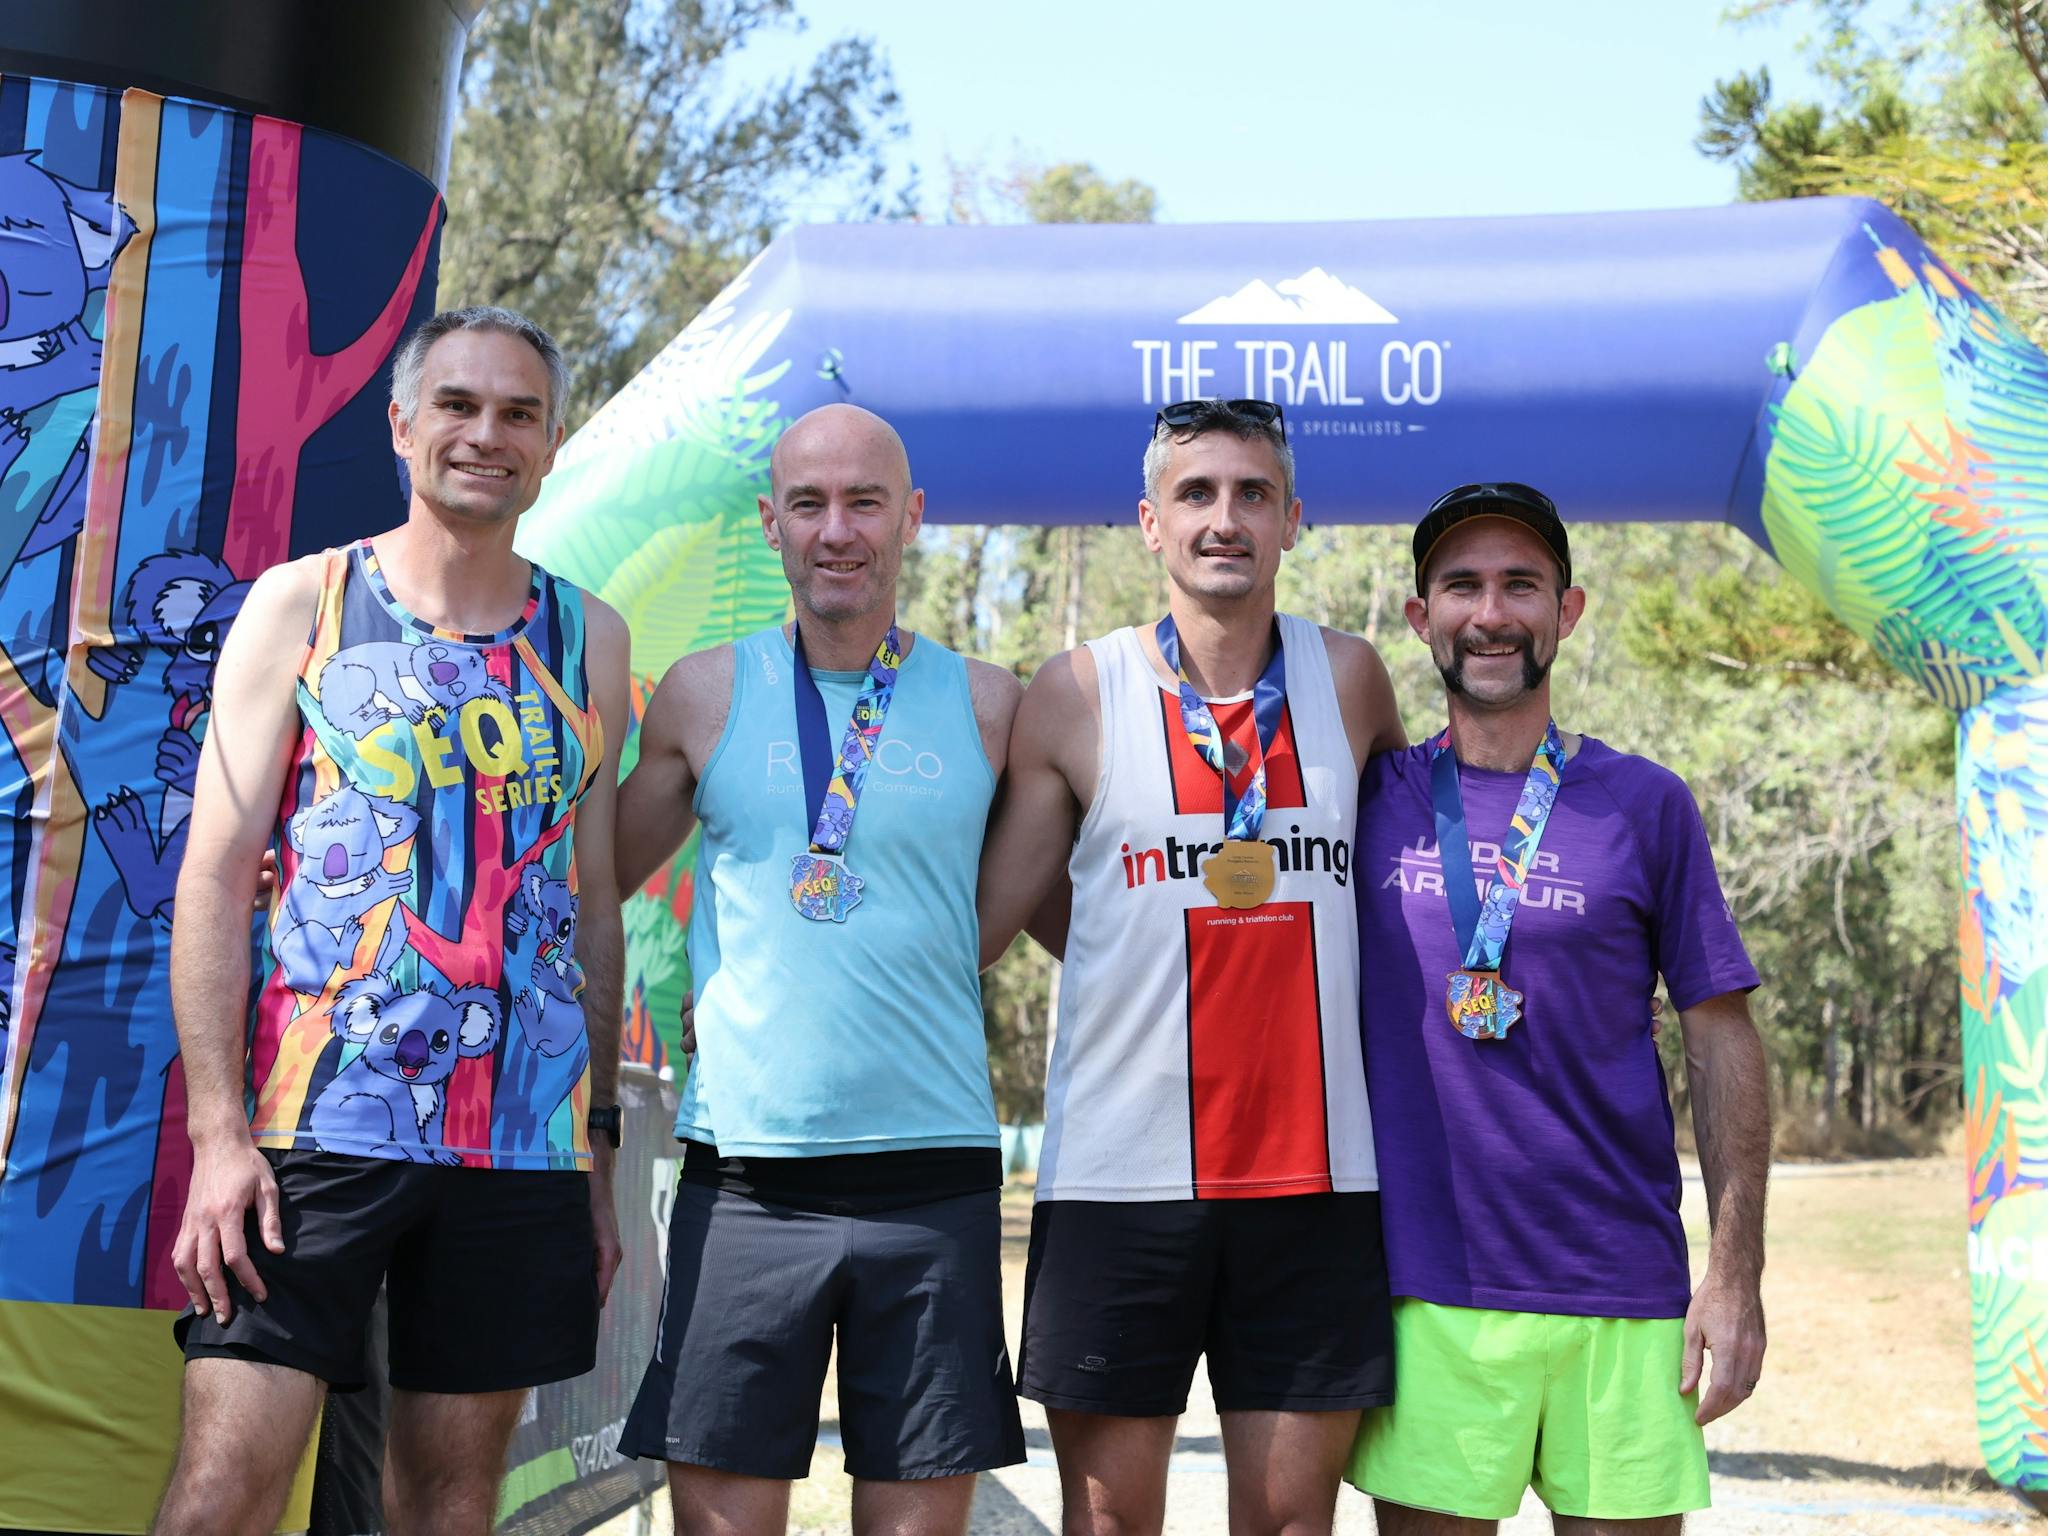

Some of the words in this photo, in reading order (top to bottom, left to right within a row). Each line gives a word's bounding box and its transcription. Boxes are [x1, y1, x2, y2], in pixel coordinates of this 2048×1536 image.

[1132, 340, 1218, 404] THE
[1234, 340, 1364, 406] TRAIL
[1380, 340, 1443, 406] CO
[1303, 420, 1403, 436] SPECIALISTS
[357, 696, 530, 804] SEQ
[515, 689, 562, 773] TRAIL
[475, 774, 564, 816] SERIES
[872, 781, 943, 798] Company
[1121, 824, 1350, 888] intrning
[1415, 835, 1560, 873] UDR
[804, 877, 832, 896] SEQ
[1380, 866, 1586, 915] ARUR
[1207, 917, 1237, 927] running
[1238, 916, 1244, 925] &
[1245, 915, 1278, 924] triathlon
[1279, 914, 1295, 922] club
[1462, 994, 1491, 1016] SEQ
